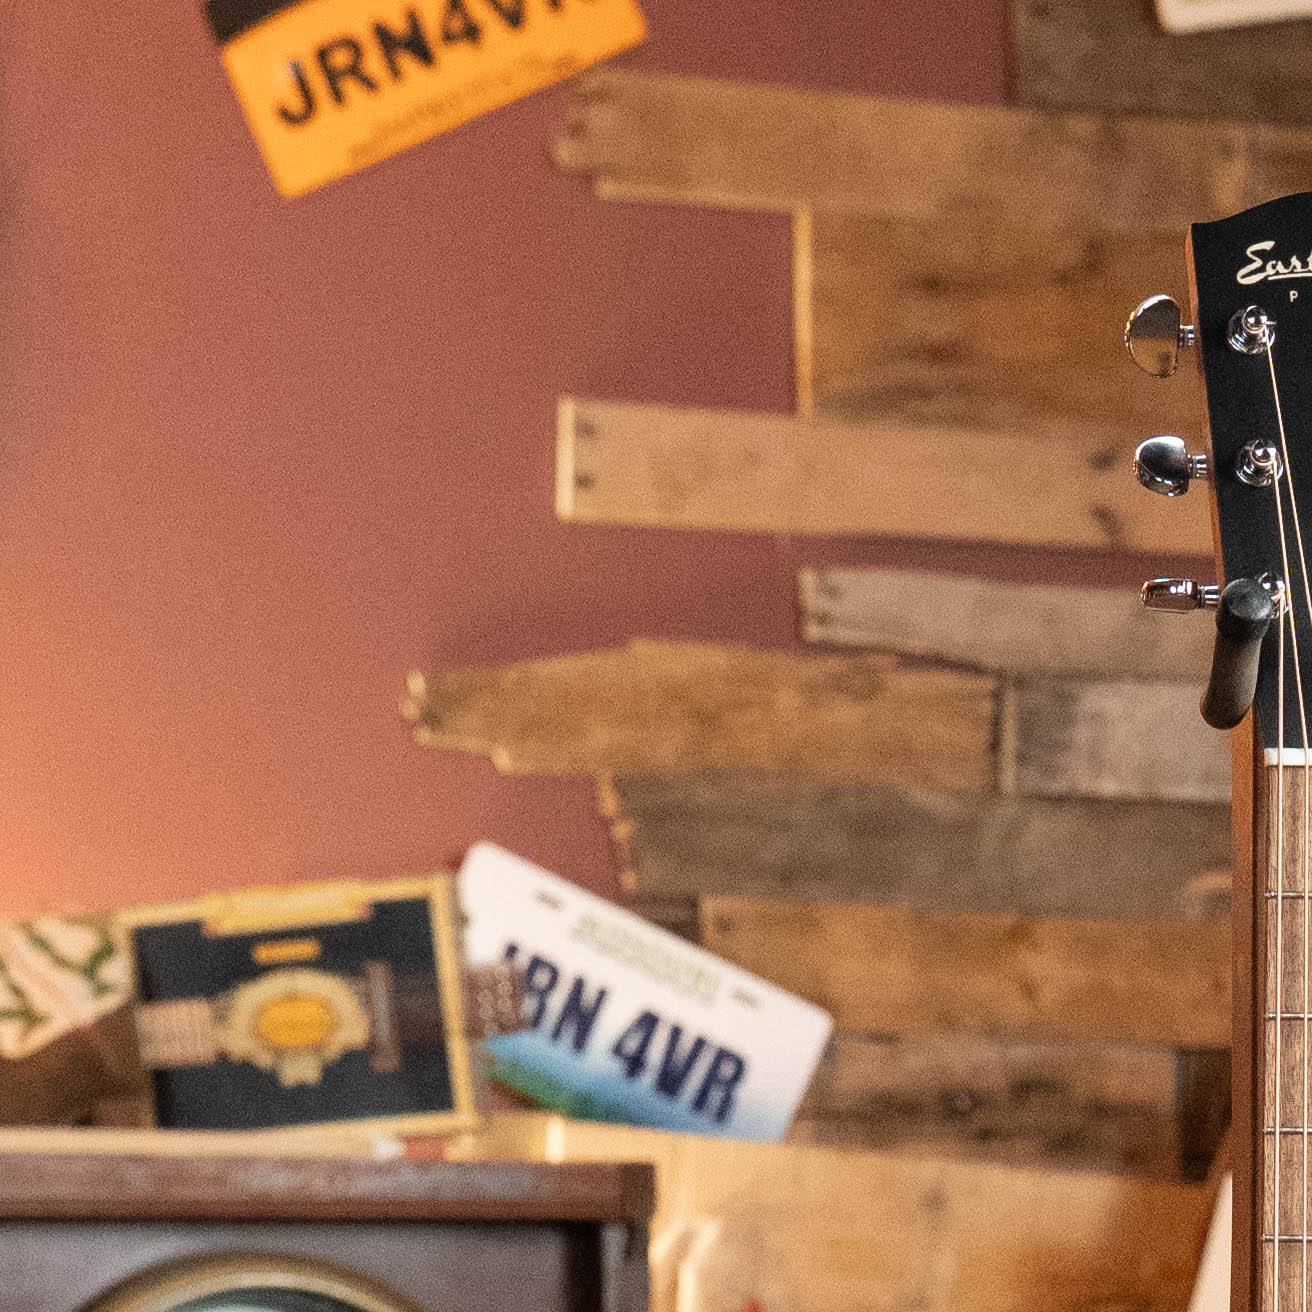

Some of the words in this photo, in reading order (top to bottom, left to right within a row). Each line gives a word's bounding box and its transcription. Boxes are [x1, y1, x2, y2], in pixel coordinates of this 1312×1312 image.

[275, 0, 580, 126] JRN4V
[504, 943, 609, 1056] RN
[610, 1009, 747, 1126] 4VR
